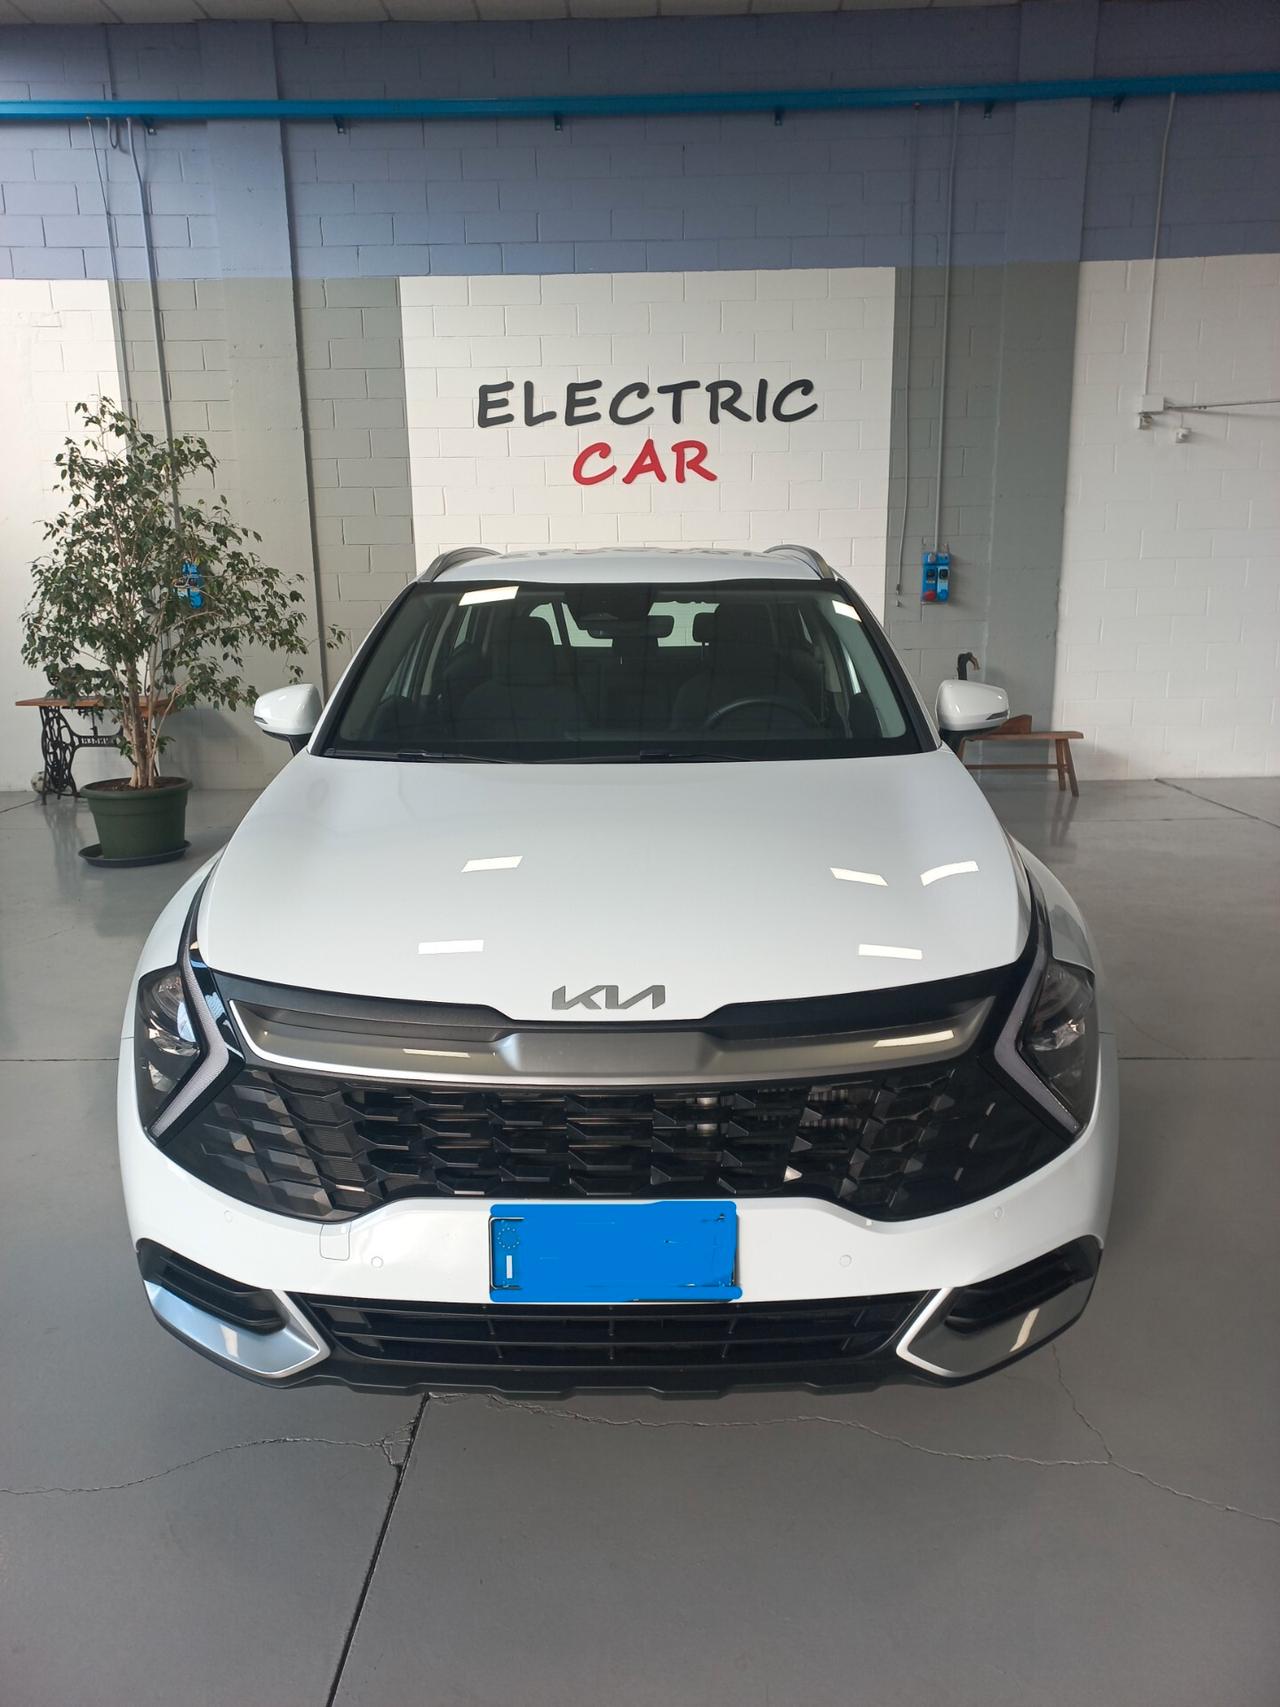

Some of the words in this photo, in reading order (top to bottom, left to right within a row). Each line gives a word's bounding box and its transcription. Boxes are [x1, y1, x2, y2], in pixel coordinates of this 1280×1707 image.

[478, 378, 818, 428] ELECTRIC
[572, 438, 718, 486] CAR
[551, 984, 666, 1010] KIA
